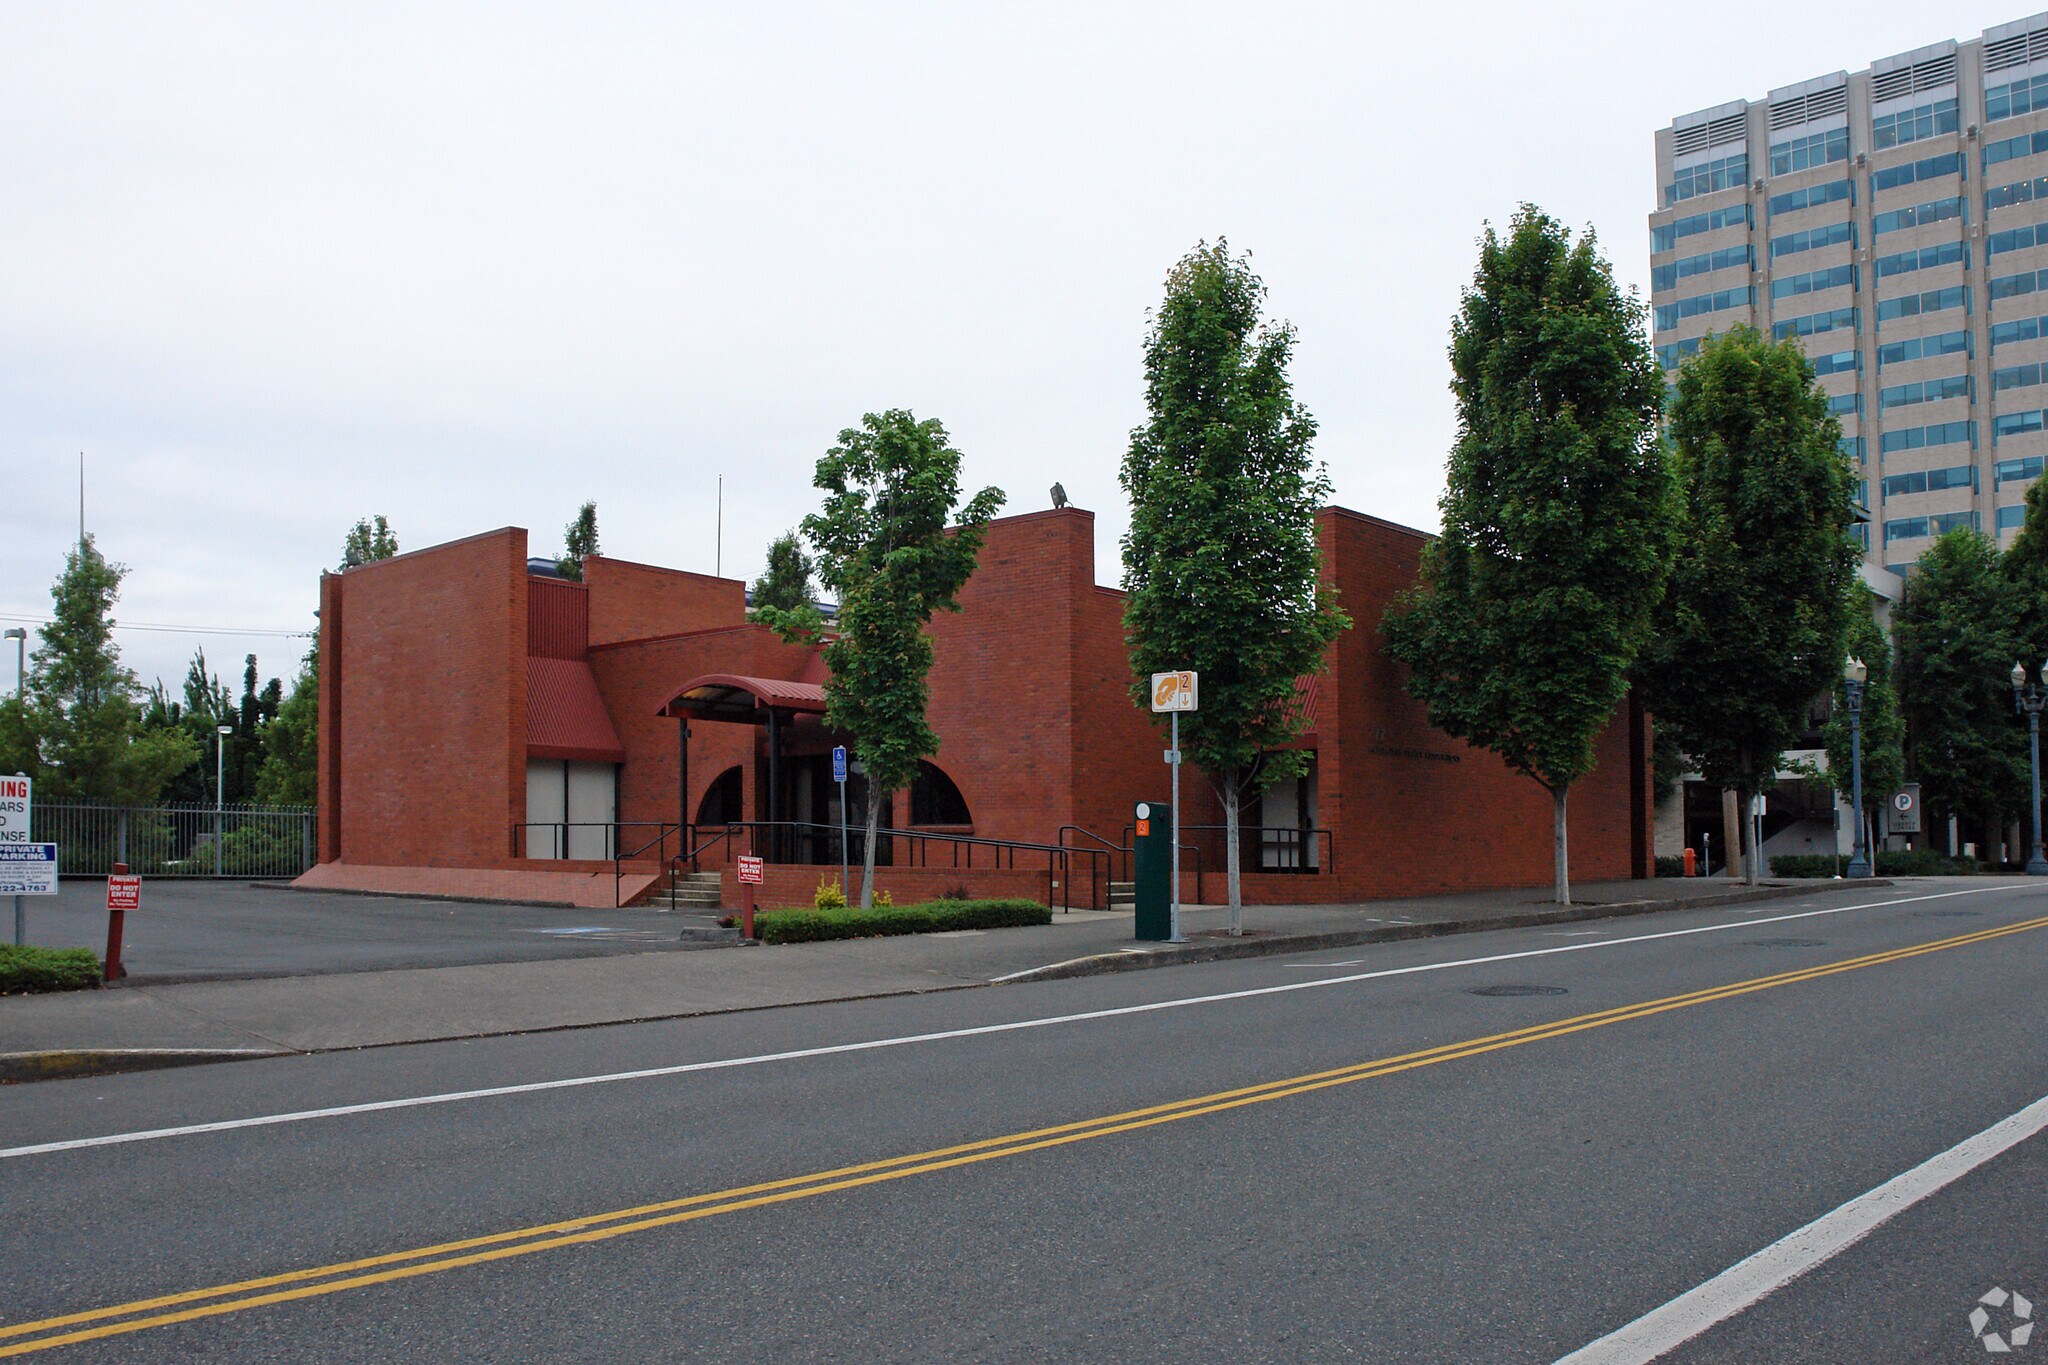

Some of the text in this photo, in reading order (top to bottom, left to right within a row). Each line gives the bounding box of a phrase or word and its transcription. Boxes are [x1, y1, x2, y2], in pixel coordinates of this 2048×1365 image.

[1182, 674, 1189, 688] 2
[1, 781, 27, 798] ING
[0, 802, 24, 813] ARS
[1900, 796, 1910, 808] P
[1139, 823, 1145, 831] 2
[0, 831, 26, 842] NSE
[0, 845, 45, 853] PRIVATE
